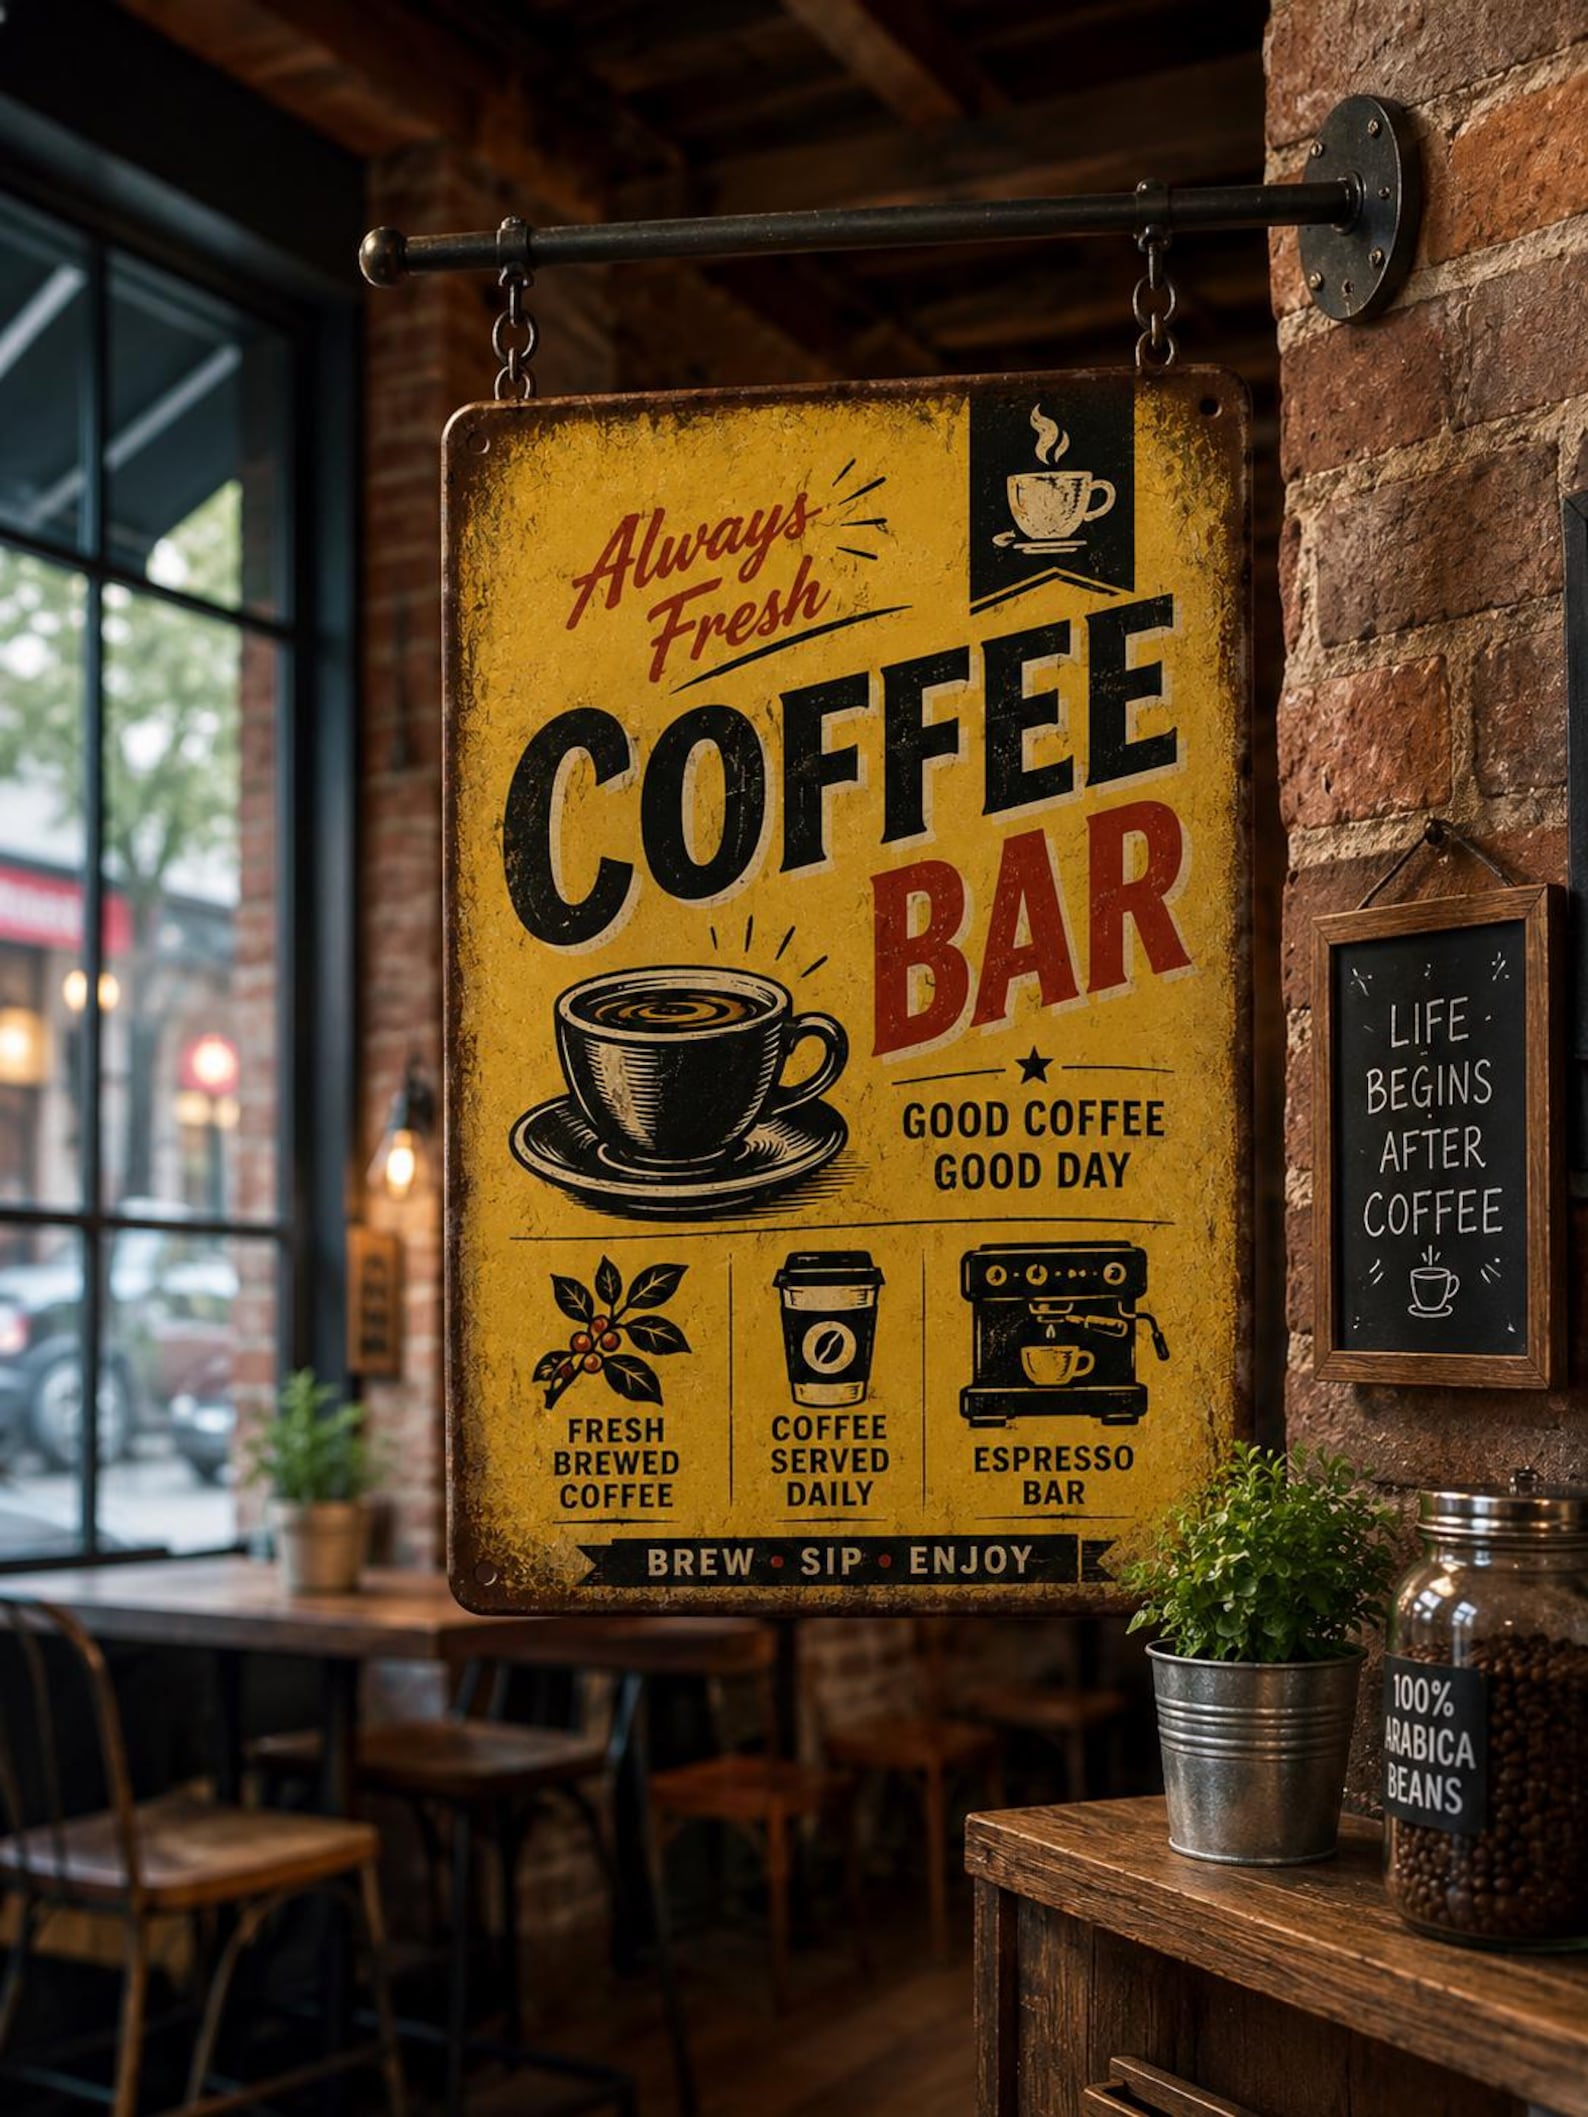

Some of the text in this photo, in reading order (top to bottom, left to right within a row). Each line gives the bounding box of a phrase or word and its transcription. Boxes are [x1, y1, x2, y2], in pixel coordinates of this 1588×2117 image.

[565, 492, 823, 631] Always
[646, 554, 831, 683] Fresh
[502, 593, 1182, 950] COFFEE
[870, 800, 1195, 1058] BAR
[1390, 996, 1469, 1048] LIFE
[1366, 1058, 1493, 1115] BEGINS
[903, 1100, 1165, 1139] GOOD COFFEE
[934, 1152, 1131, 1190] GOOD DAY
[1379, 1126, 1487, 1174] AFTER
[1363, 1187, 1503, 1238] COFFEE
[568, 1417, 665, 1443] FRESH
[771, 1415, 887, 1441] COFFEE
[553, 1450, 679, 1476] BREWED
[771, 1448, 889, 1474] SERVED
[973, 1446, 1134, 1473] ESPRESSO
[560, 1483, 674, 1509] COFFEE
[786, 1481, 874, 1507] DAILY
[1023, 1480, 1085, 1506] BAR
[647, 1544, 1033, 1577] BREW SIP ENJOY
[1393, 1672, 1455, 1717] 100%
[1384, 1714, 1477, 1769] ARABICA
[1387, 1761, 1464, 1815] BEANS
